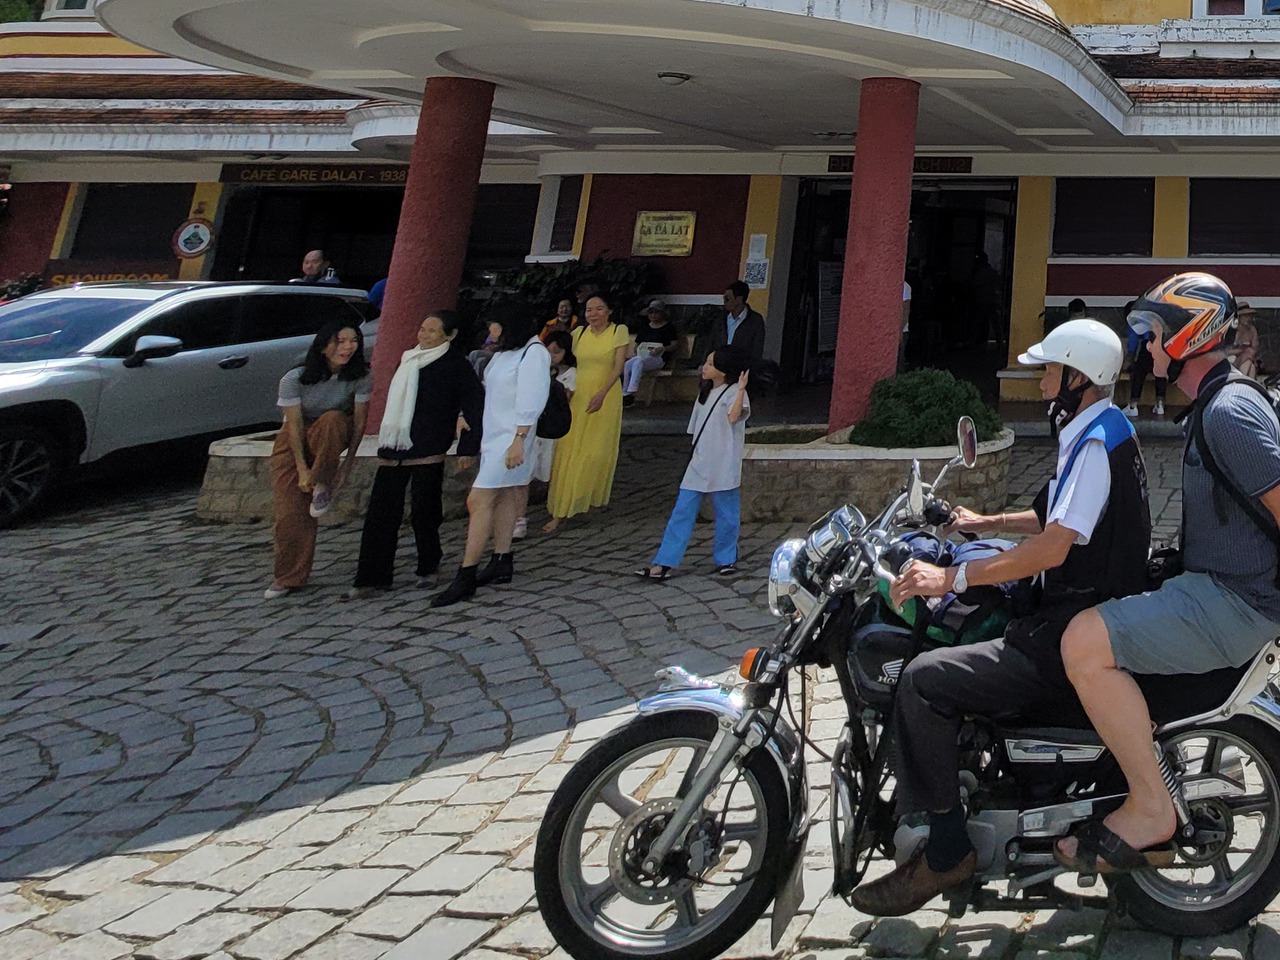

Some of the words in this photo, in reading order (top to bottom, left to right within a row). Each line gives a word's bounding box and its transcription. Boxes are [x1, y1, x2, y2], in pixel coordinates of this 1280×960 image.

[279, 169, 317, 181] GARE
[321, 170, 366, 181] DALAT
[379, 170, 406, 181] 1938
